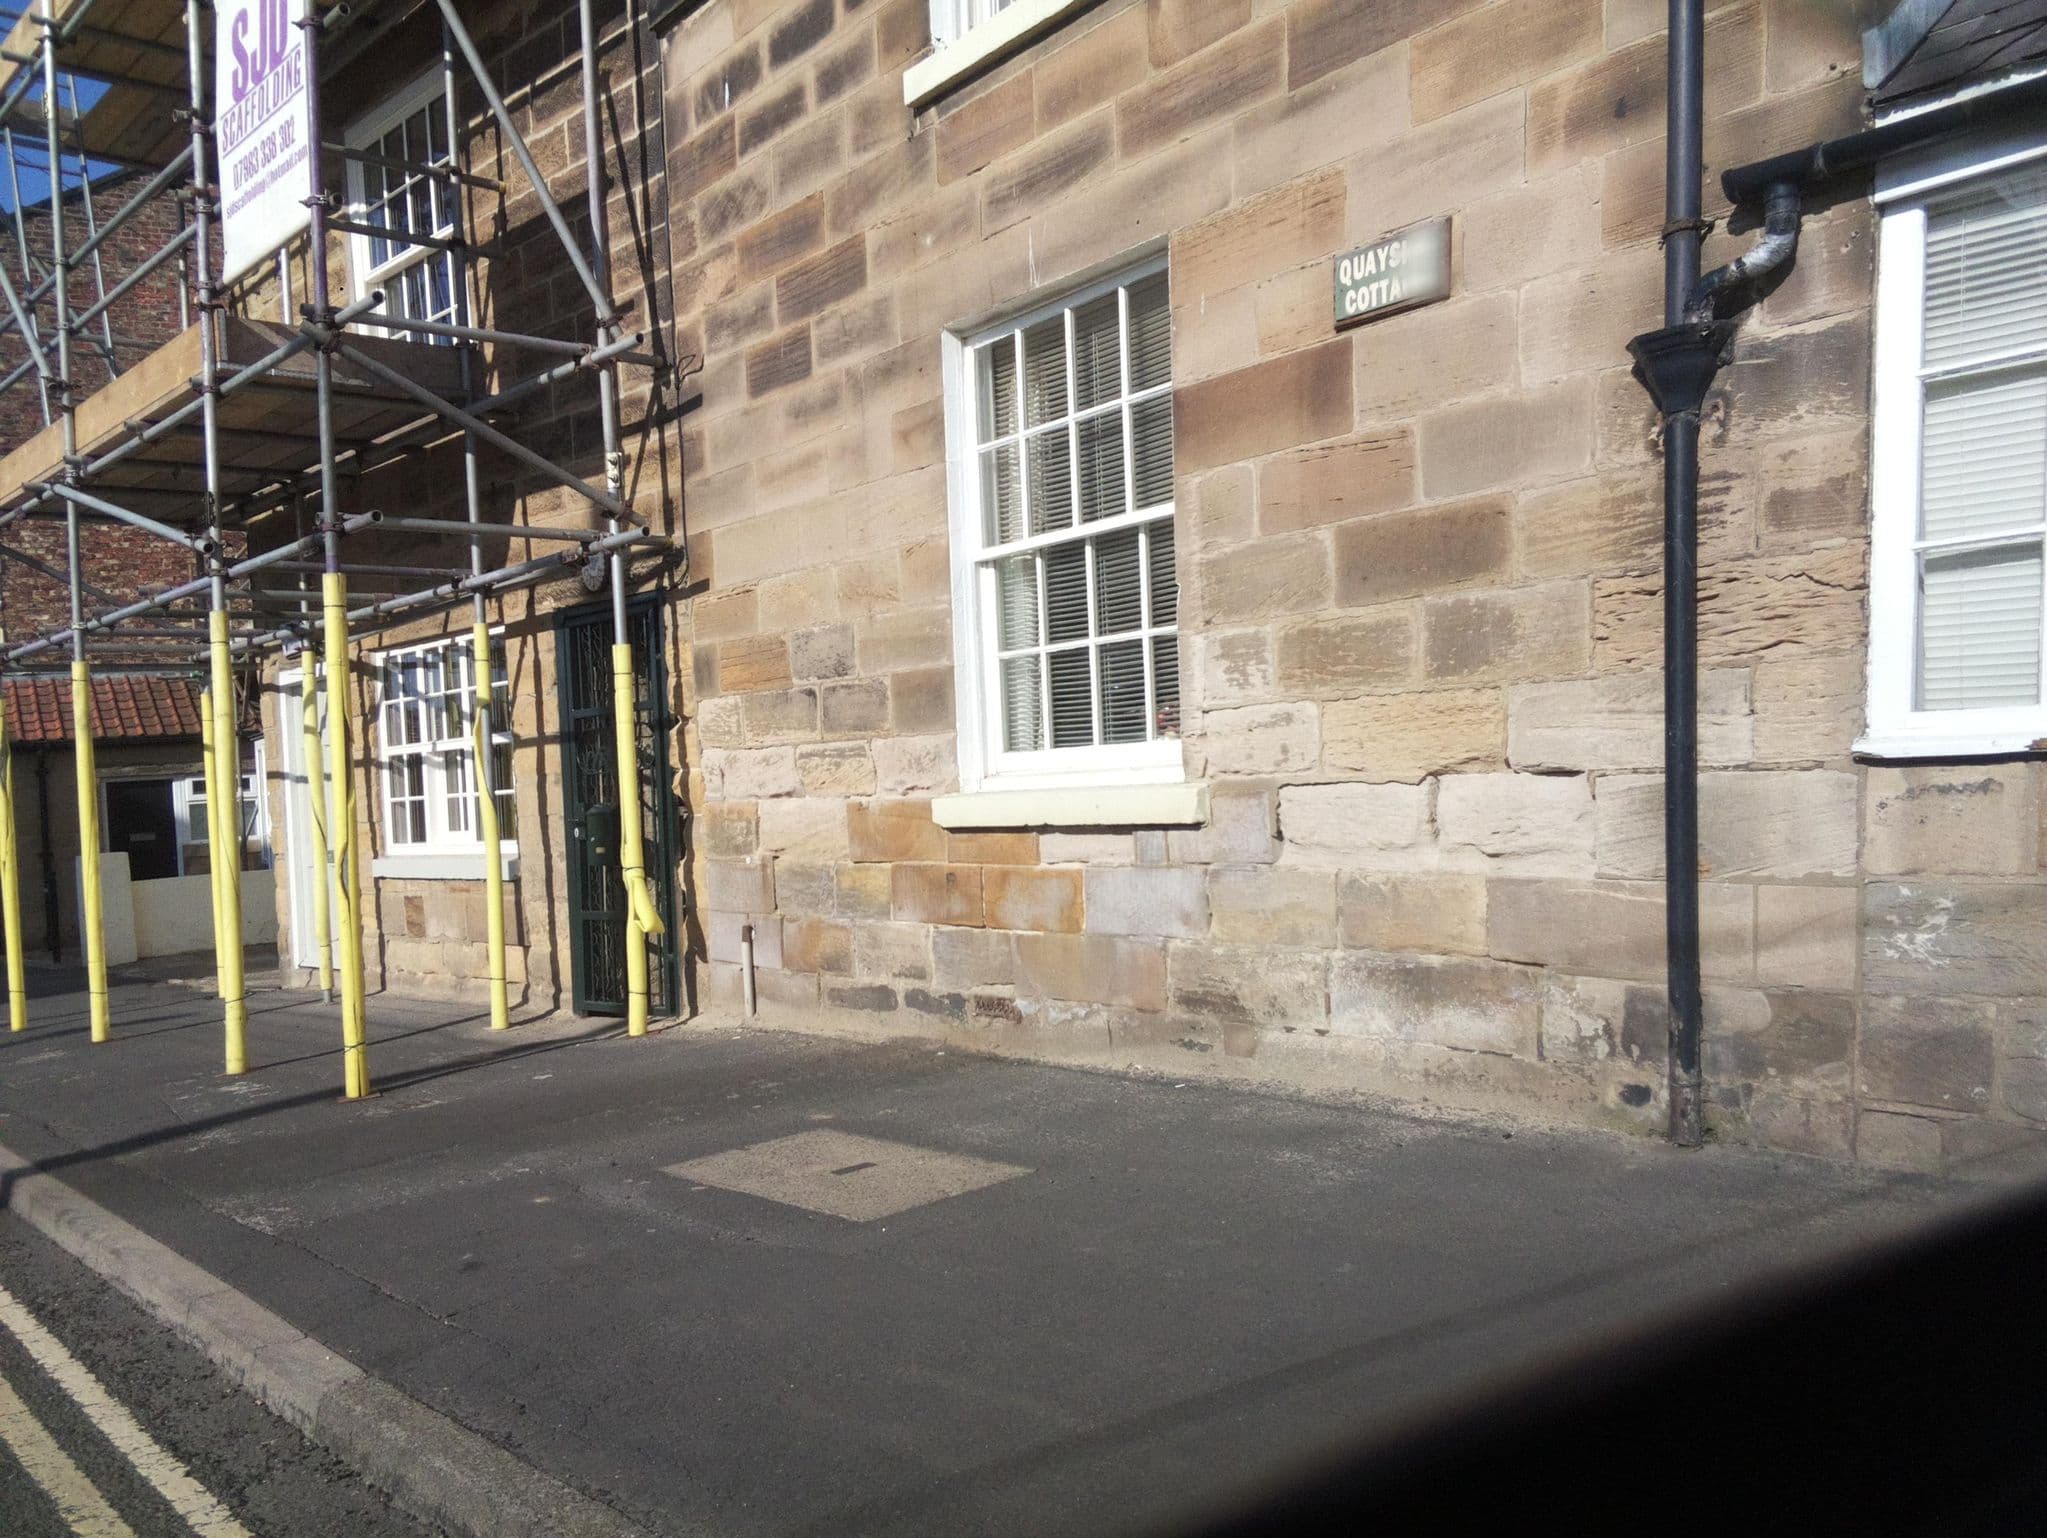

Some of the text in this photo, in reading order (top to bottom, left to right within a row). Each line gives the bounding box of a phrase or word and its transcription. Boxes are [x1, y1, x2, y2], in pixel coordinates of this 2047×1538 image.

[232, 0, 288, 104] SJD
[222, 48, 302, 153] SCAFFOLDING
[260, 131, 278, 168] 338
[279, 114, 296, 153] 302
[1345, 273, 1411, 314] COTTA
